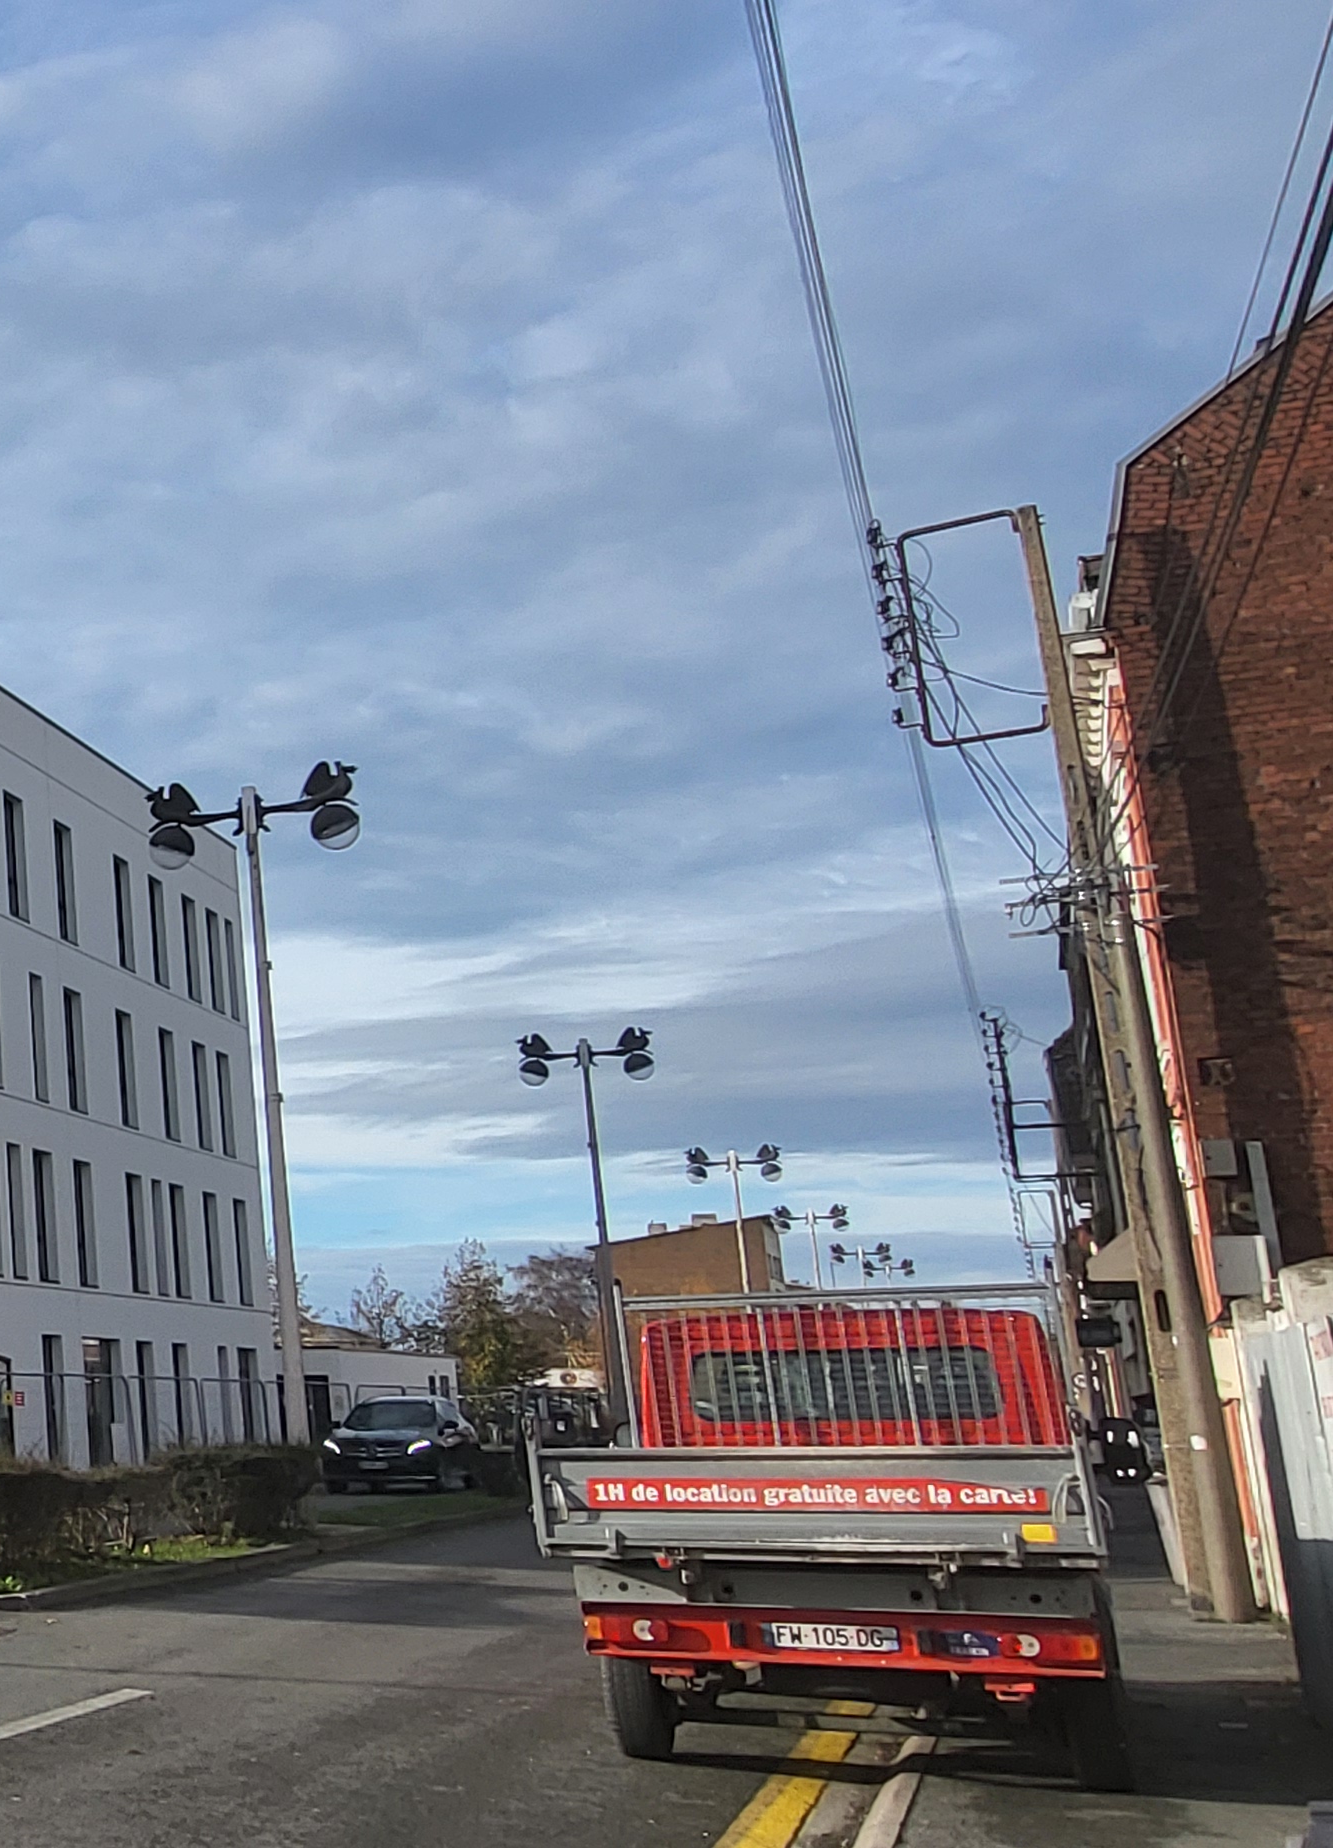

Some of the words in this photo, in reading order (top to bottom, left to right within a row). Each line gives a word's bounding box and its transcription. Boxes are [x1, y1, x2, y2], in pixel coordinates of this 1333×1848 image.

[594, 1483, 625, 1502] 1H
[632, 1484, 659, 1502] de
[665, 1484, 757, 1503] location
[763, 1484, 858, 1506] gratuite
[865, 1486, 921, 1504] avec
[928, 1484, 952, 1504] la
